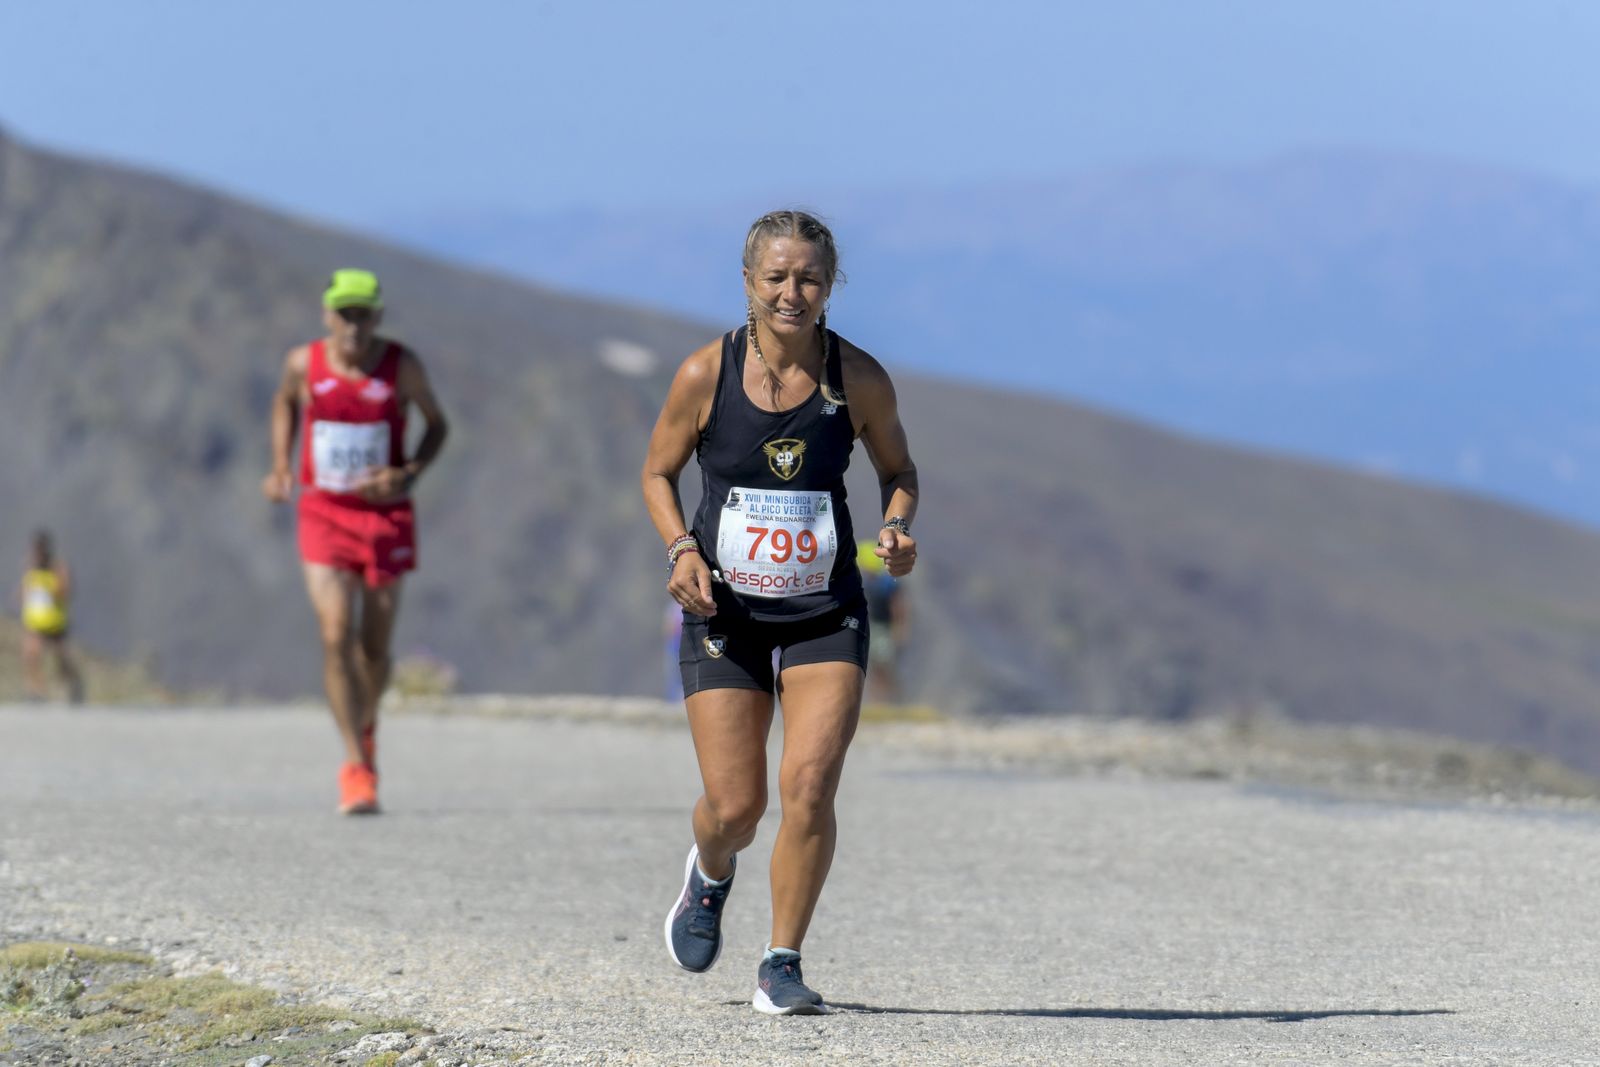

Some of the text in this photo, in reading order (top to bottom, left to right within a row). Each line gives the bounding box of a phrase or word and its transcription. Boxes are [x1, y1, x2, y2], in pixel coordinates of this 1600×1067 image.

[744, 493, 811, 505] XVIII MINISUBIDA
[749, 504, 759, 513] AL
[761, 504, 781, 514] PICO
[784, 506, 812, 516] VELETA
[745, 514, 817, 523] EWELINA BEDNARCZYK
[746, 526, 818, 564] 799
